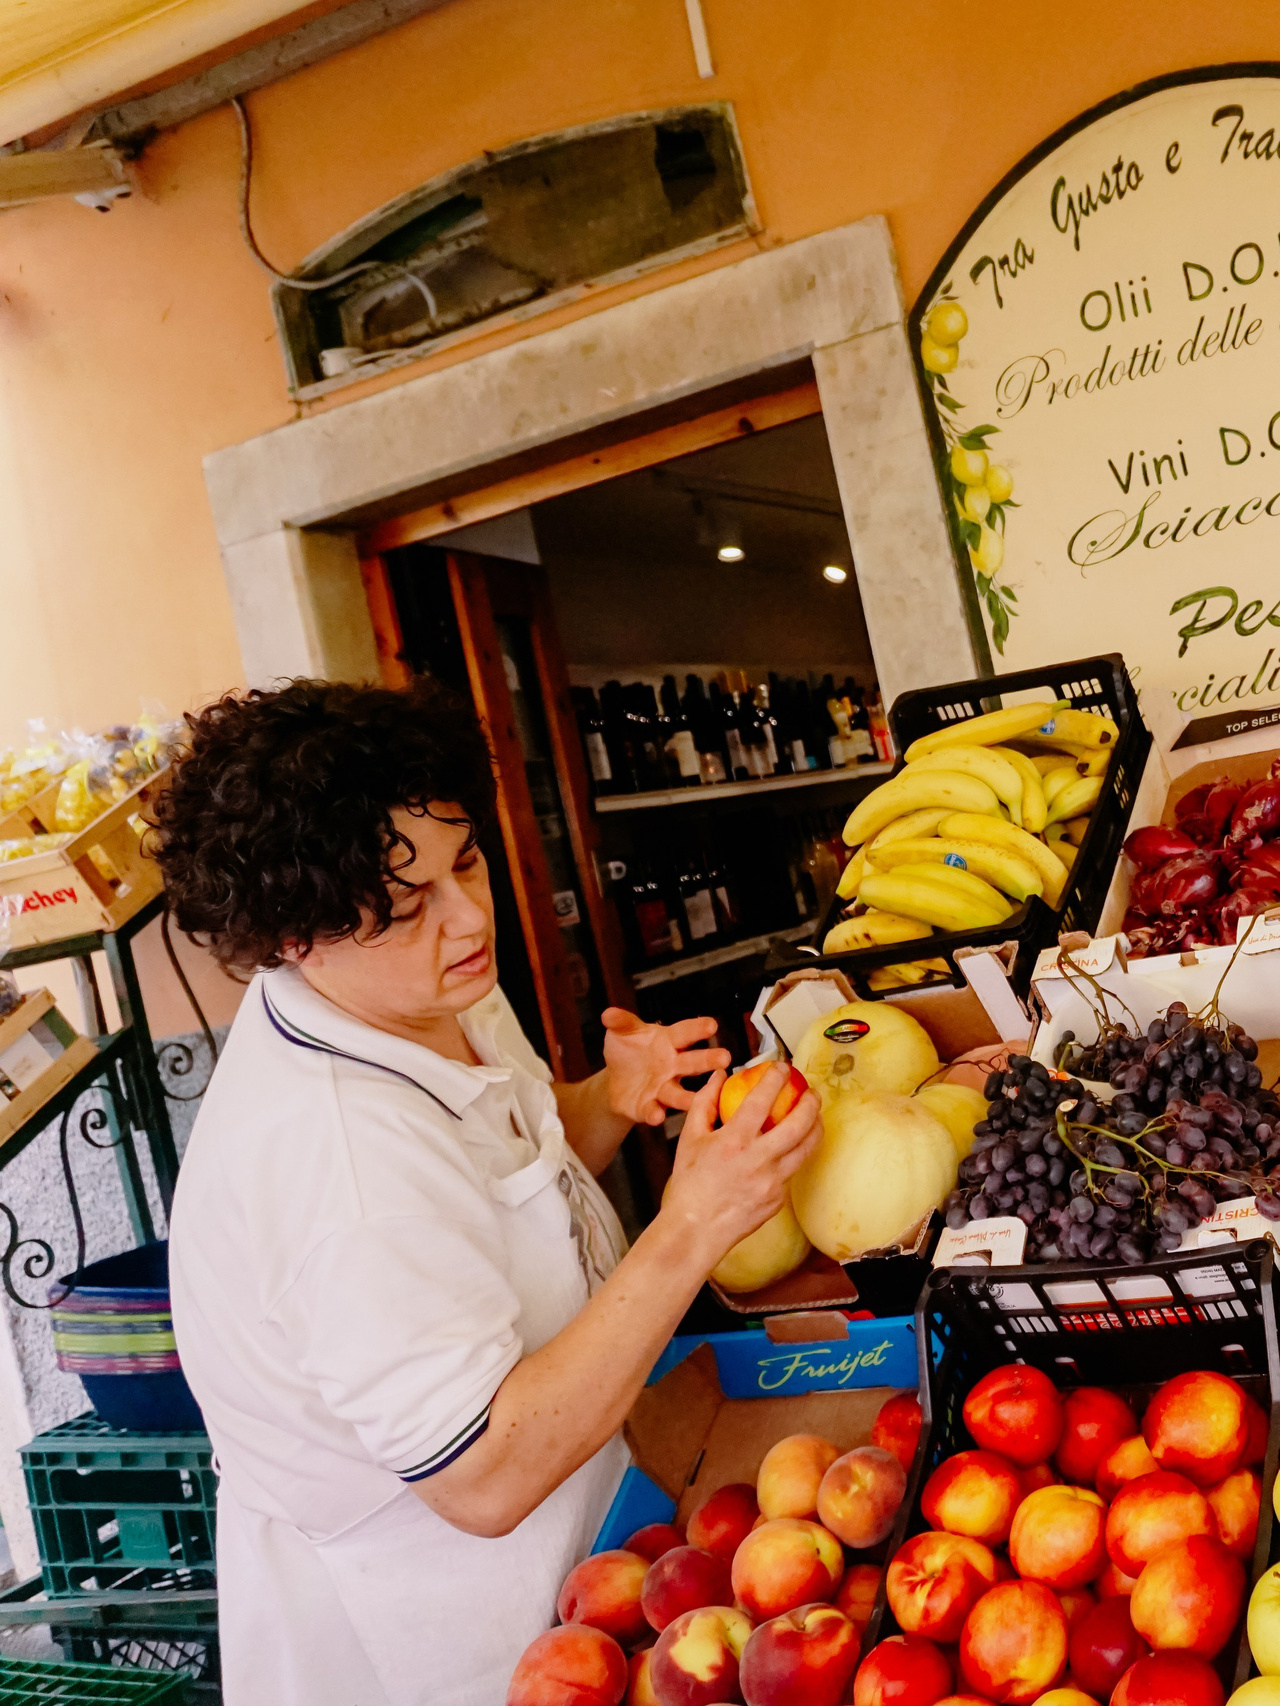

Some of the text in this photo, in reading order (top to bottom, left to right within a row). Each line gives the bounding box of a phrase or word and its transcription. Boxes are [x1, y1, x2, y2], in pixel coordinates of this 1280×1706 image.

[970, 237, 1034, 307] Tra
[1050, 155, 1144, 250] Gusto
[1165, 140, 1182, 173] e
[1080, 275, 1152, 331] Olii
[996, 339, 1166, 420] Prodotti
[1177, 303, 1263, 366] delle
[1107, 438, 1188, 494] Vini
[1226, 721, 1248, 734] TOP
[1040, 957, 1099, 972] CRSINA
[1200, 1207, 1260, 1224] CRISTIN
[757, 1340, 895, 1390] Fruijet
